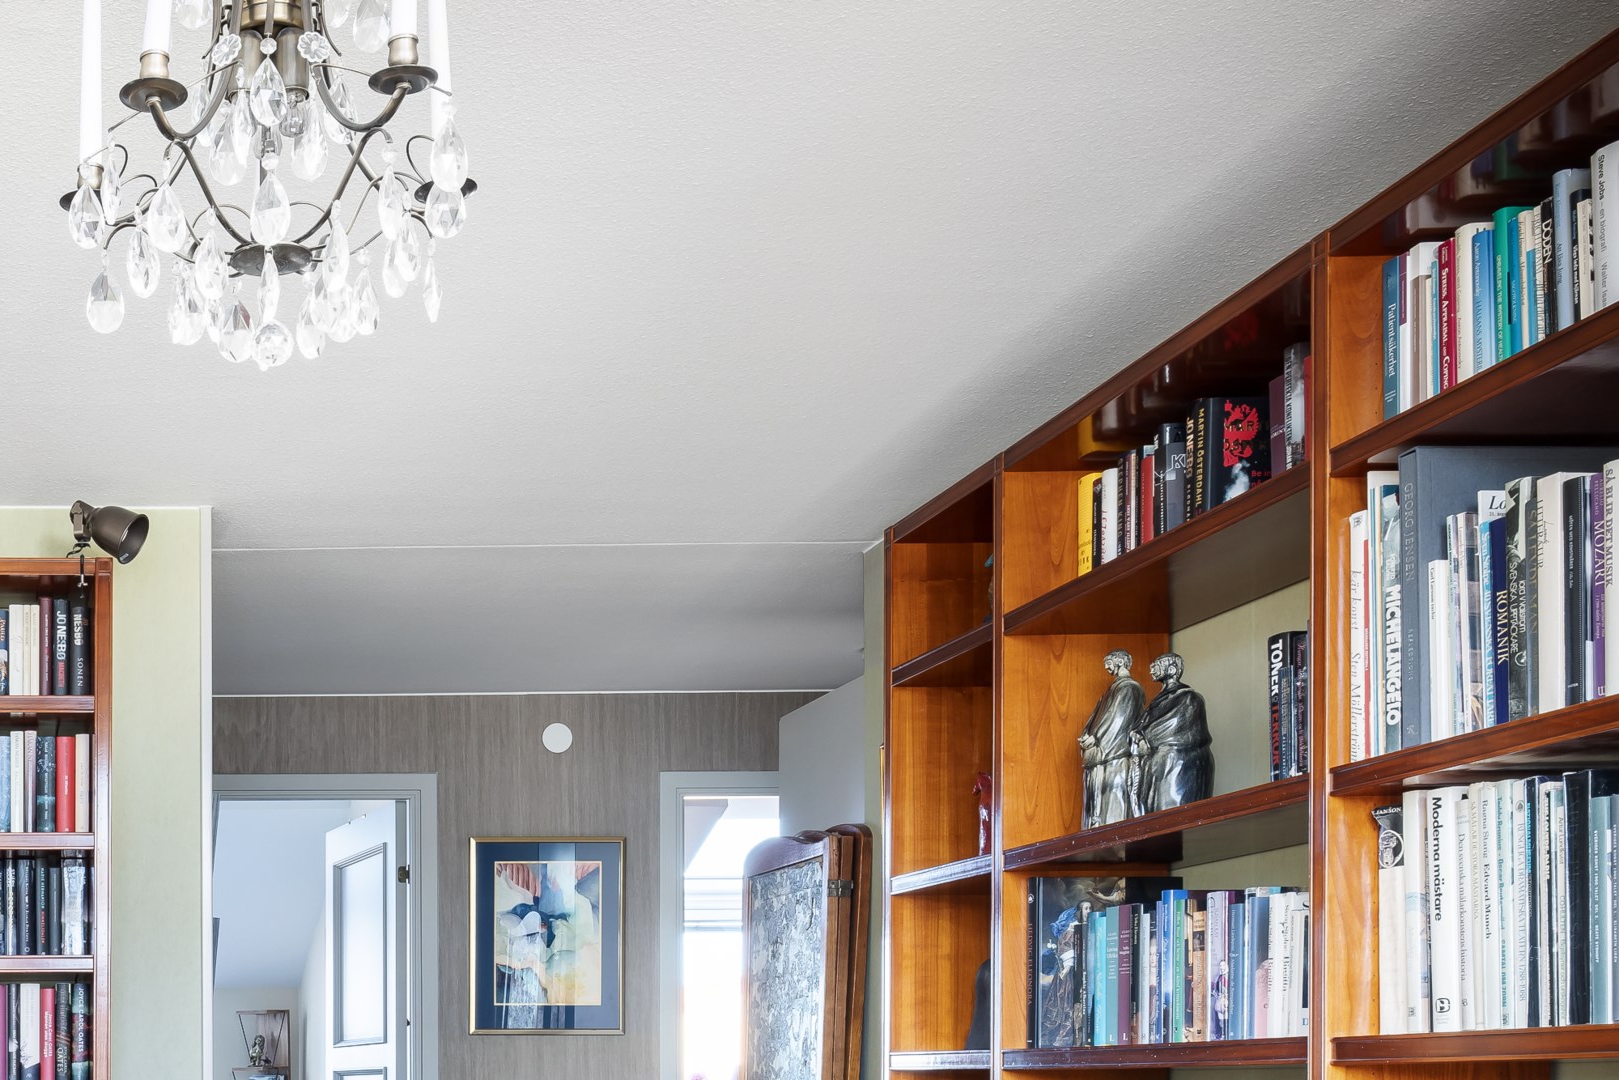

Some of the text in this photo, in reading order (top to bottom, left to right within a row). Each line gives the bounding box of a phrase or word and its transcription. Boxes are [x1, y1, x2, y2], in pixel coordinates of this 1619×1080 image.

[1542, 218, 1554, 265] DÖDEN
[1597, 154, 1608, 290] Steve Jobs en biografi Walter
[1554, 267, 1563, 285] Jung
[1387, 303, 1397, 378] Patientsäkerhet
[1441, 268, 1451, 390] STRESS, APPRAISAL, COPING
[1186, 417, 1194, 432] JO
[1195, 408, 1205, 508] MARTIN ÖSTERDAHL
[1403, 481, 1415, 583] GEORG JENSEN
[1594, 520, 1605, 588] MOZART
[1604, 468, 1615, 589] SÅ BLIR DET MUSIK
[56, 611, 66, 661] JO NESBØ
[73, 614, 82, 646] NESBØ
[1350, 570, 1363, 679] kär konst Sten
[1480, 531, 1494, 652] Sven Stolpe SVENSKA
[1495, 589, 1509, 666] ROMANIK
[1508, 561, 1520, 655] SVENSKA UPPTÄCKARE
[1385, 584, 1402, 726] MICHELANGELO
[1430, 797, 1445, 922] Moderna mästare
[1482, 832, 1490, 859] Stang
[1483, 863, 1491, 902] Edvard
[1457, 832, 1468, 982] Den svenska målarkonstens historia
